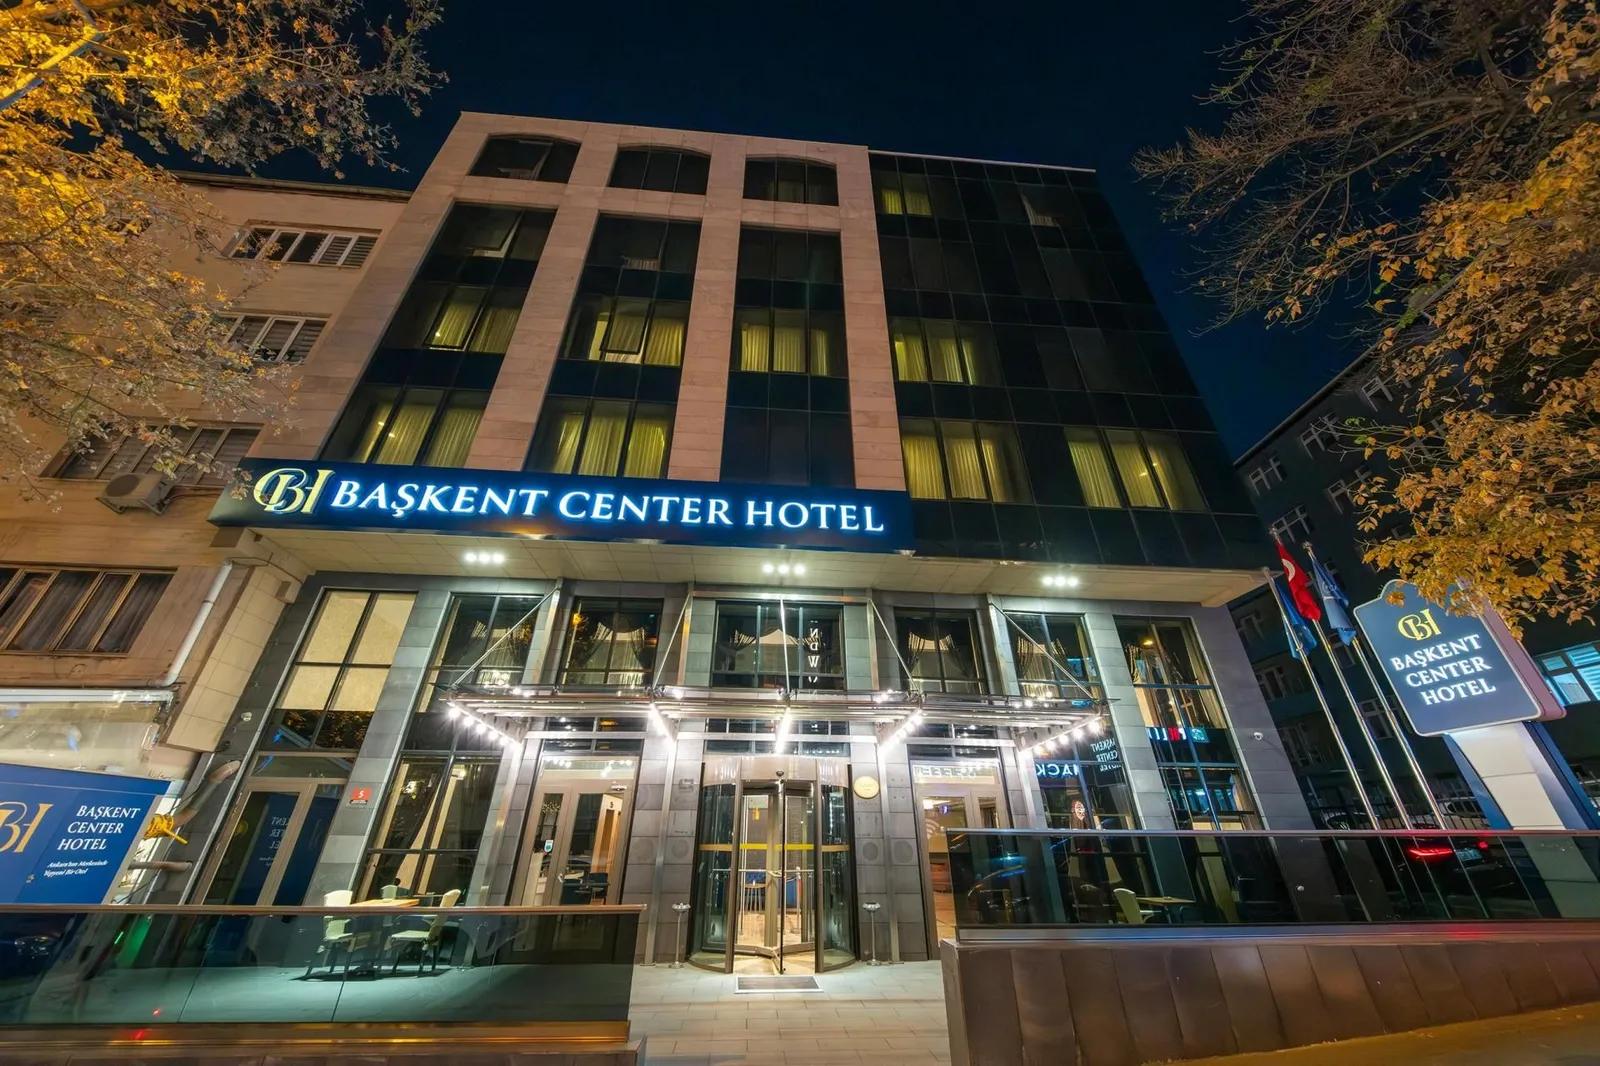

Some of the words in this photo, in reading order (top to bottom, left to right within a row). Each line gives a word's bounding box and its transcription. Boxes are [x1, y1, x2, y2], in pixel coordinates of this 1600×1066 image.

[330, 480, 549, 517] BAŞKENT
[558, 491, 733, 526] CENTER
[746, 500, 884, 533] HOTEL
[1390, 634, 1482, 671] BAŞKENT
[1405, 656, 1492, 688] CENTER
[1420, 678, 1496, 706] HOTEL
[76, 805, 141, 820] BAŞKENT
[67, 821, 124, 834] CENTER
[57, 838, 107, 850] HOTEL
